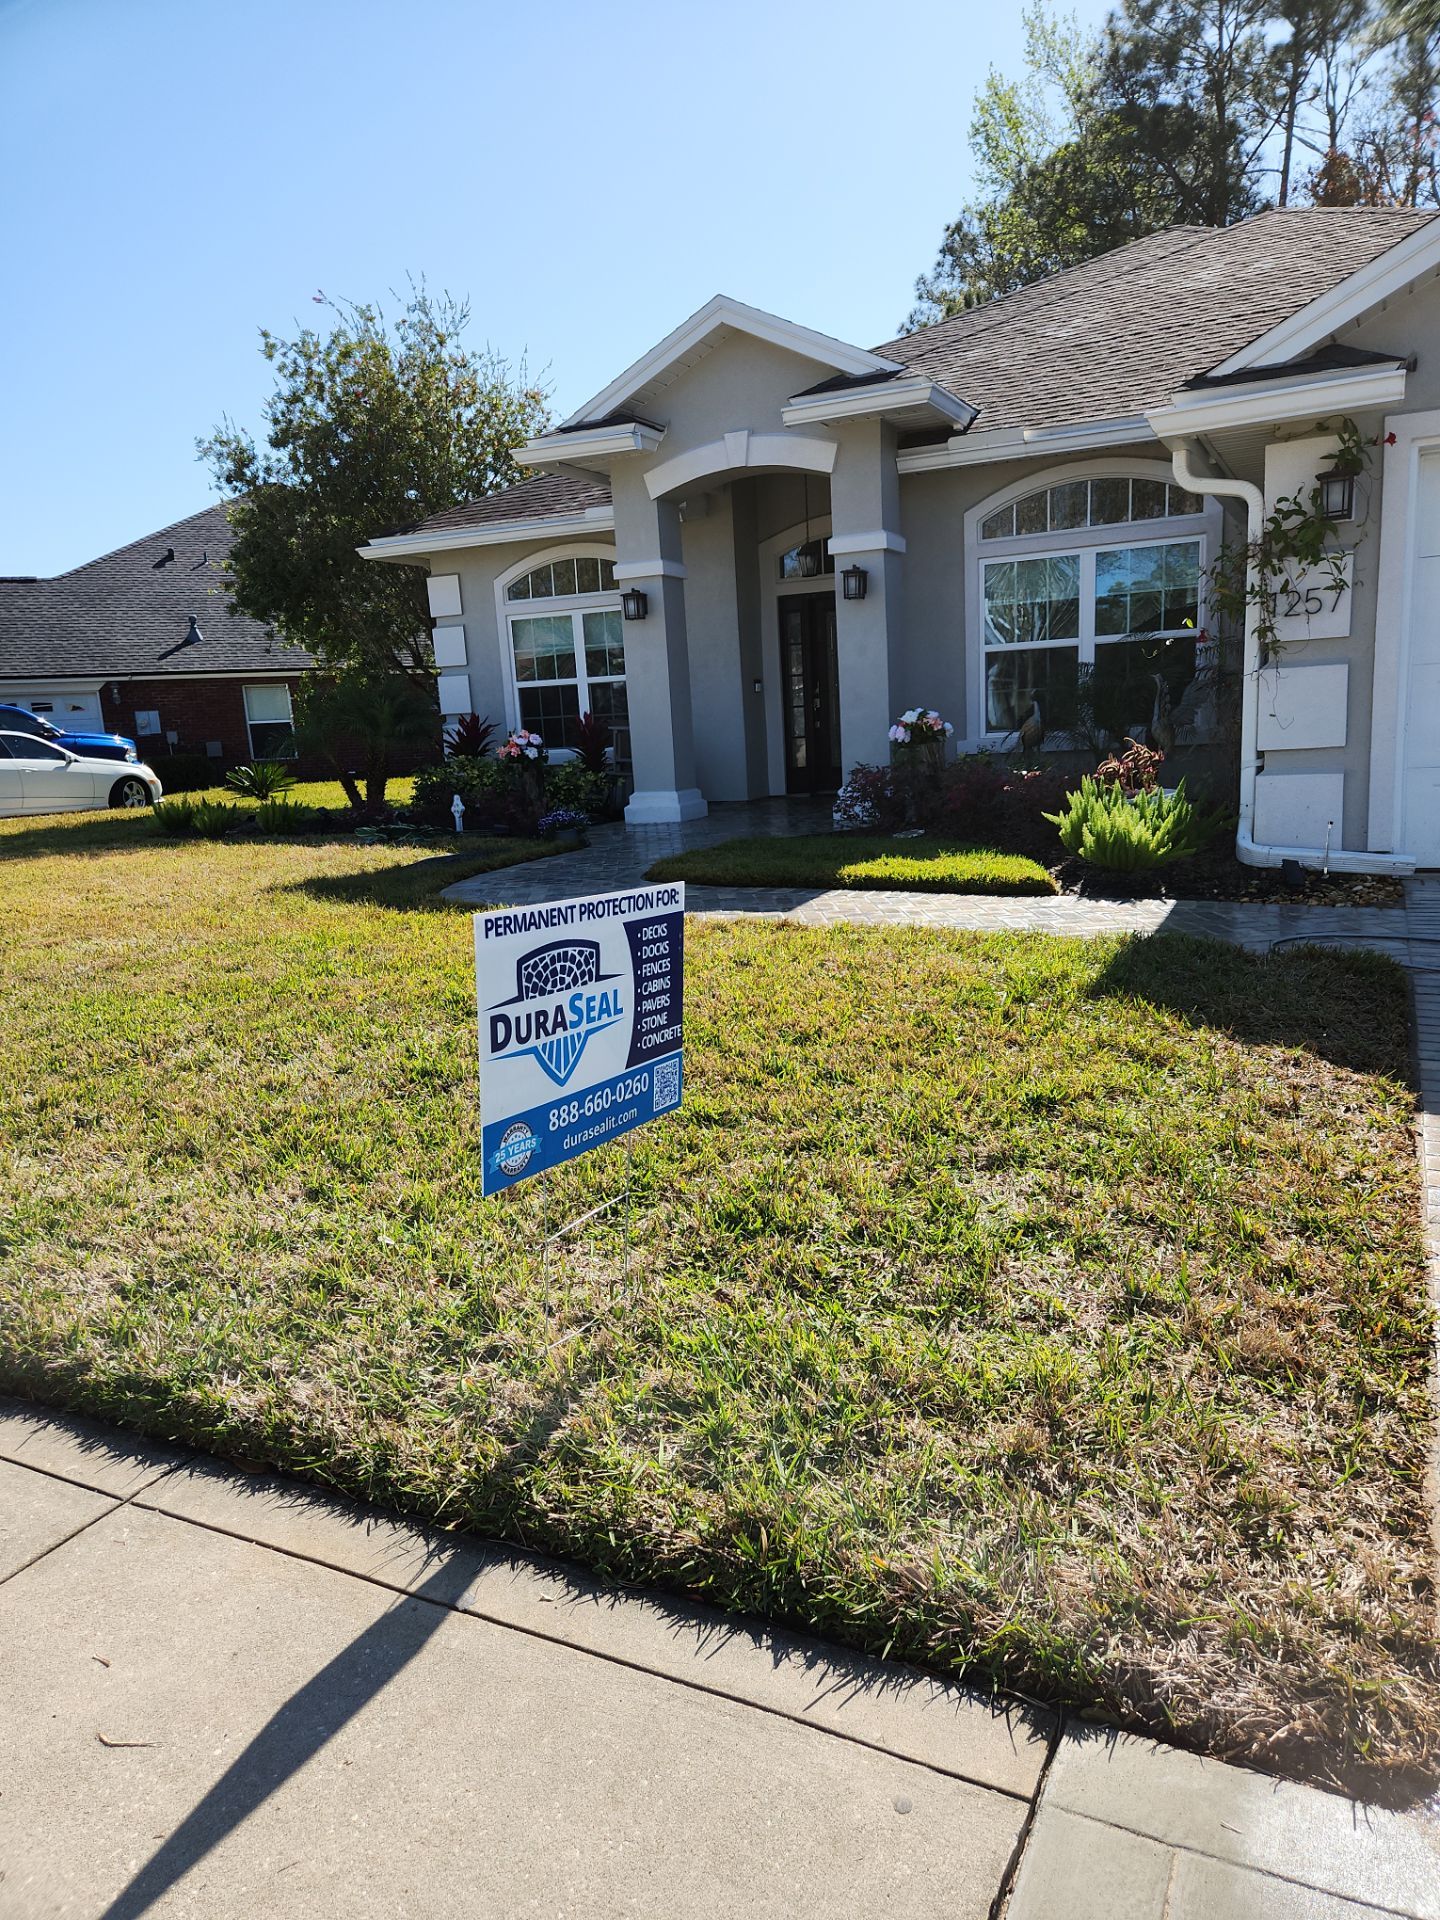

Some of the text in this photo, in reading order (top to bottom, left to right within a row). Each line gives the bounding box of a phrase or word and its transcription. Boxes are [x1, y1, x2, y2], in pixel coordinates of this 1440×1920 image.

[484, 888, 679, 939] PERMANENT PROTECTION FOR:
[642, 923, 667, 940] DECKS
[642, 941, 669, 959] DOCKS
[642, 958, 670, 977] FENCES
[642, 978, 671, 996] CABINS
[642, 995, 670, 1014] PAVERS
[642, 1012, 667, 1032] STONE
[642, 1025, 681, 1049] CONCRETE
[549, 1072, 649, 1132] 888-660-0260
[503, 1123, 529, 1143] WARRANTY
[563, 1106, 637, 1149] durasealit.com
[495, 1138, 536, 1164] 25 YEARS
[502, 1155, 530, 1175] WARRANTY
